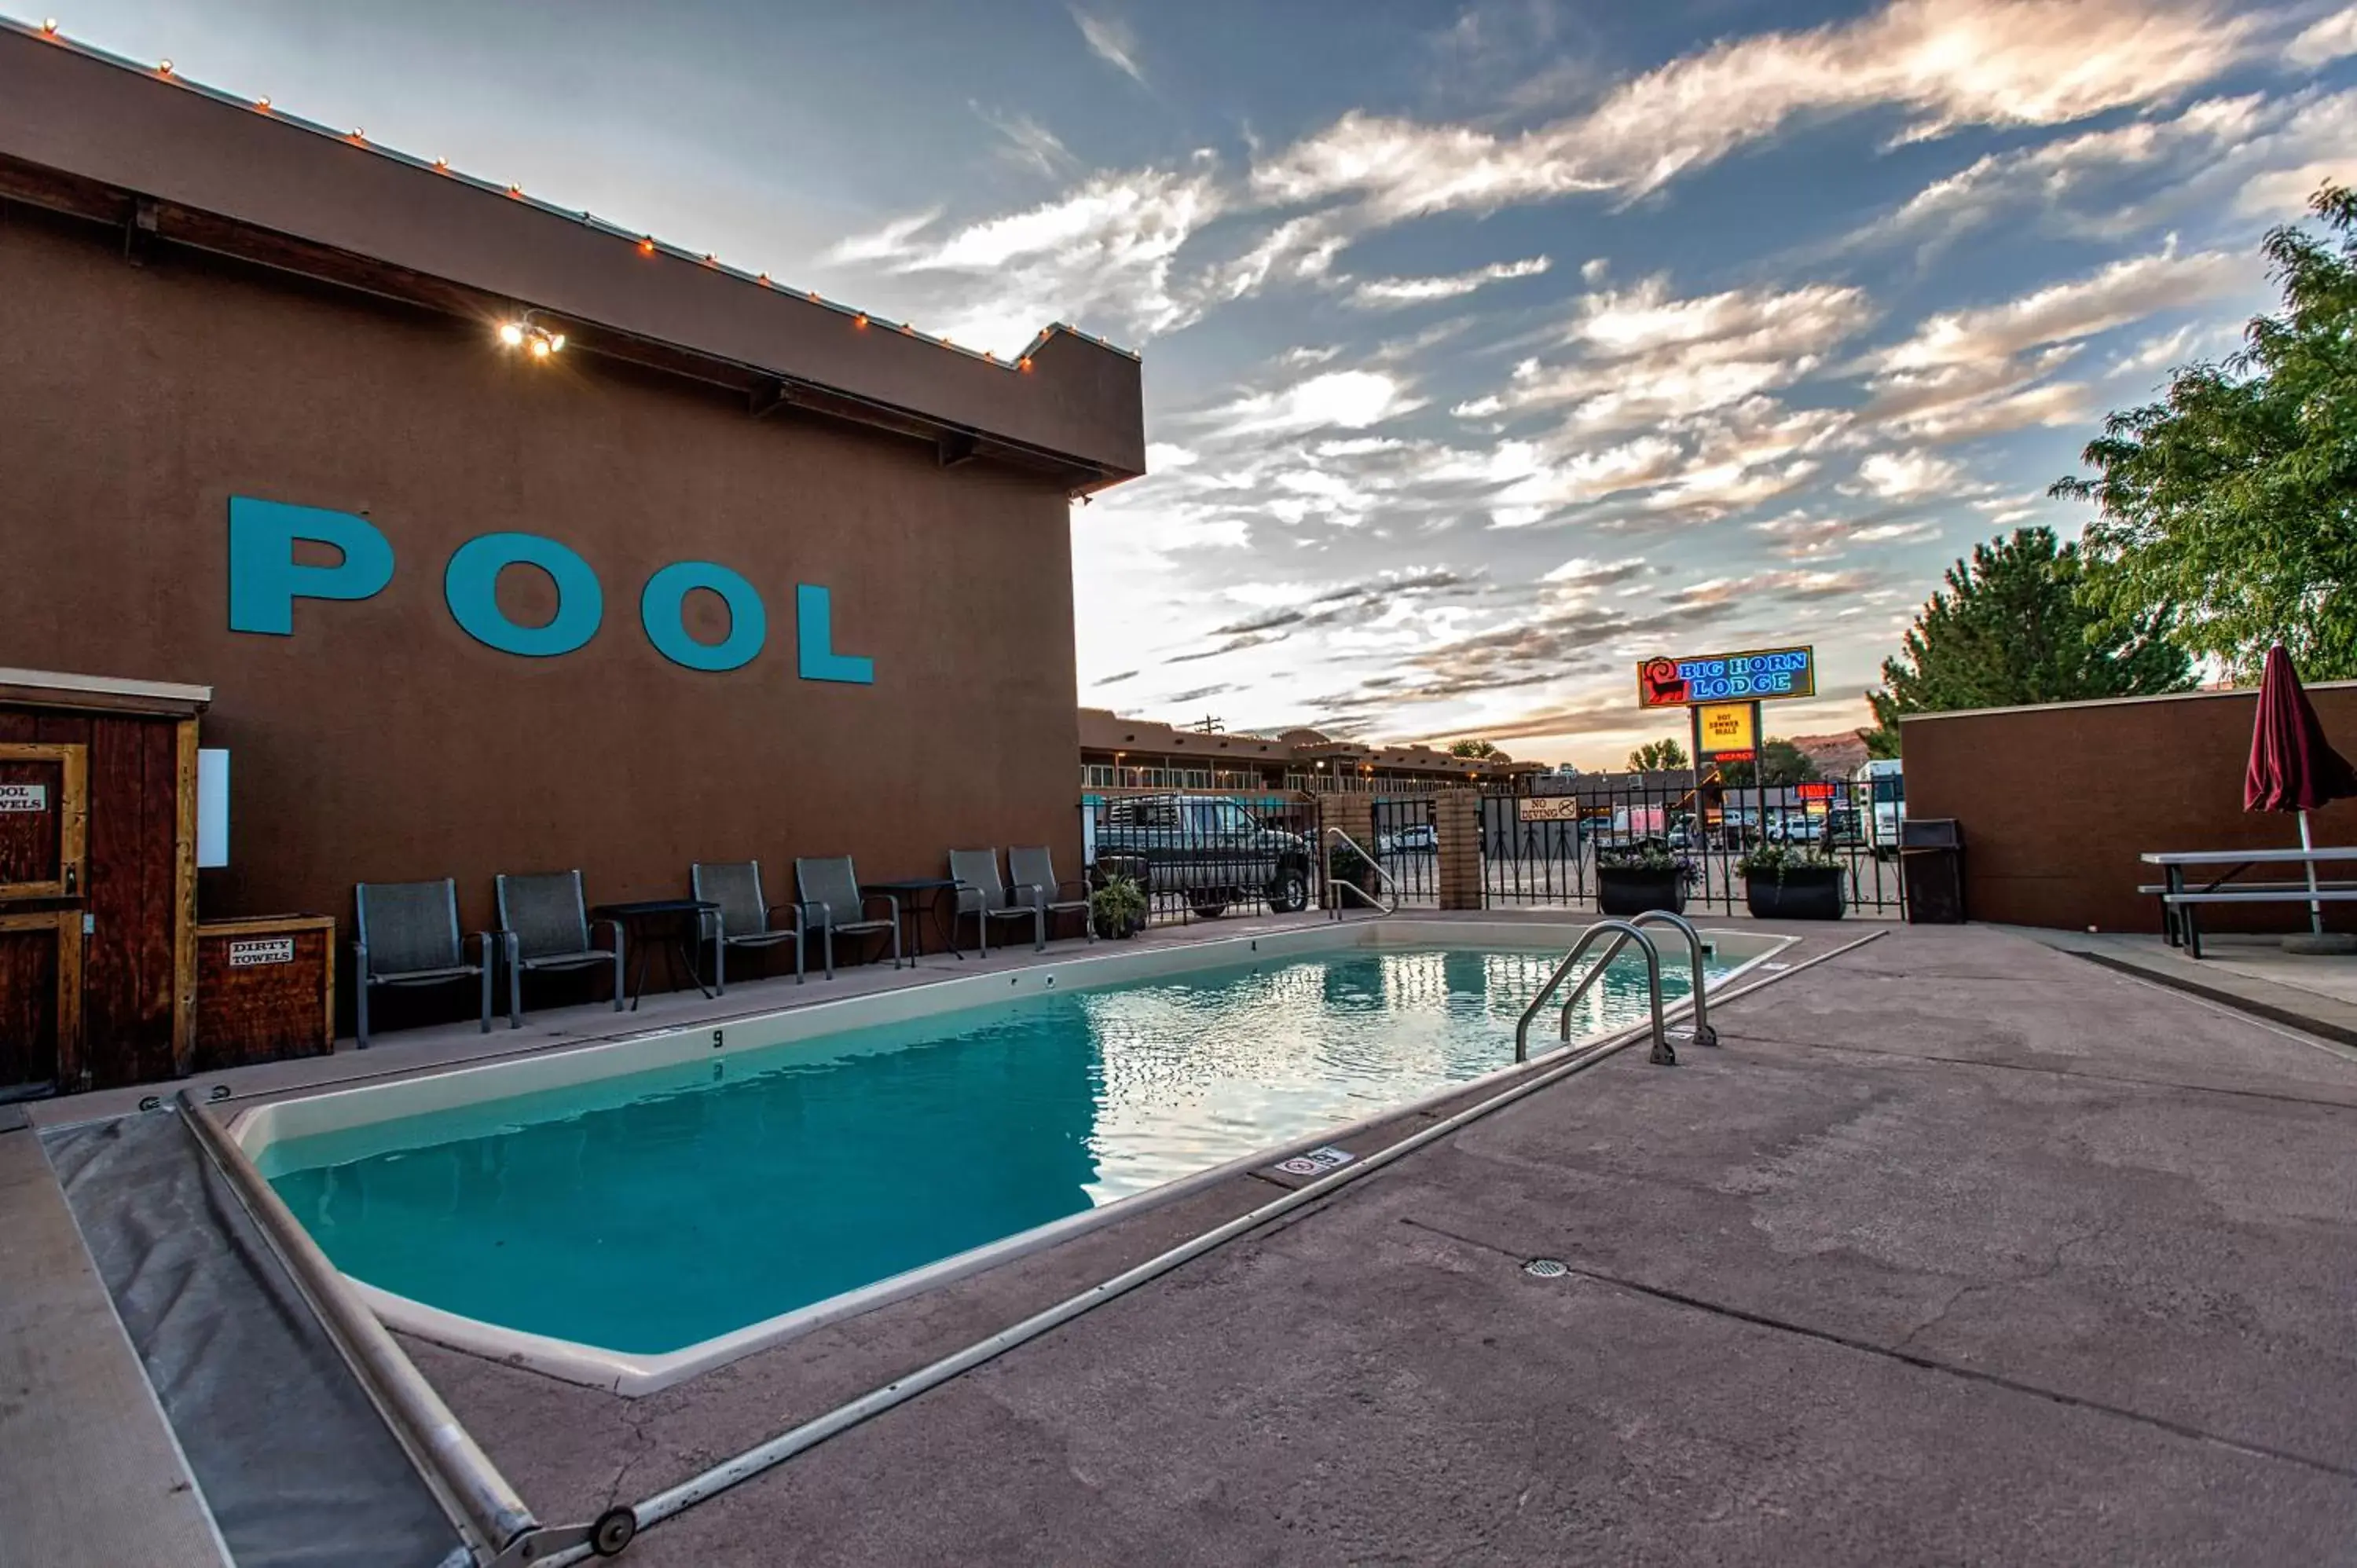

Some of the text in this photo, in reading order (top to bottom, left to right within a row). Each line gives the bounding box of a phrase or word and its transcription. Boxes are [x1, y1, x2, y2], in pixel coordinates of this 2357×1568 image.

[228, 495, 874, 684] POOL
[1678, 652, 1806, 680] BIG HORN
[1692, 672, 1791, 697] LODGE
[1531, 798, 1546, 808] NO
[1522, 808, 1557, 819] DIVING
[233, 941, 289, 953] DIRTY
[232, 952, 289, 964] TOWELS
[713, 1030, 723, 1049] 9
